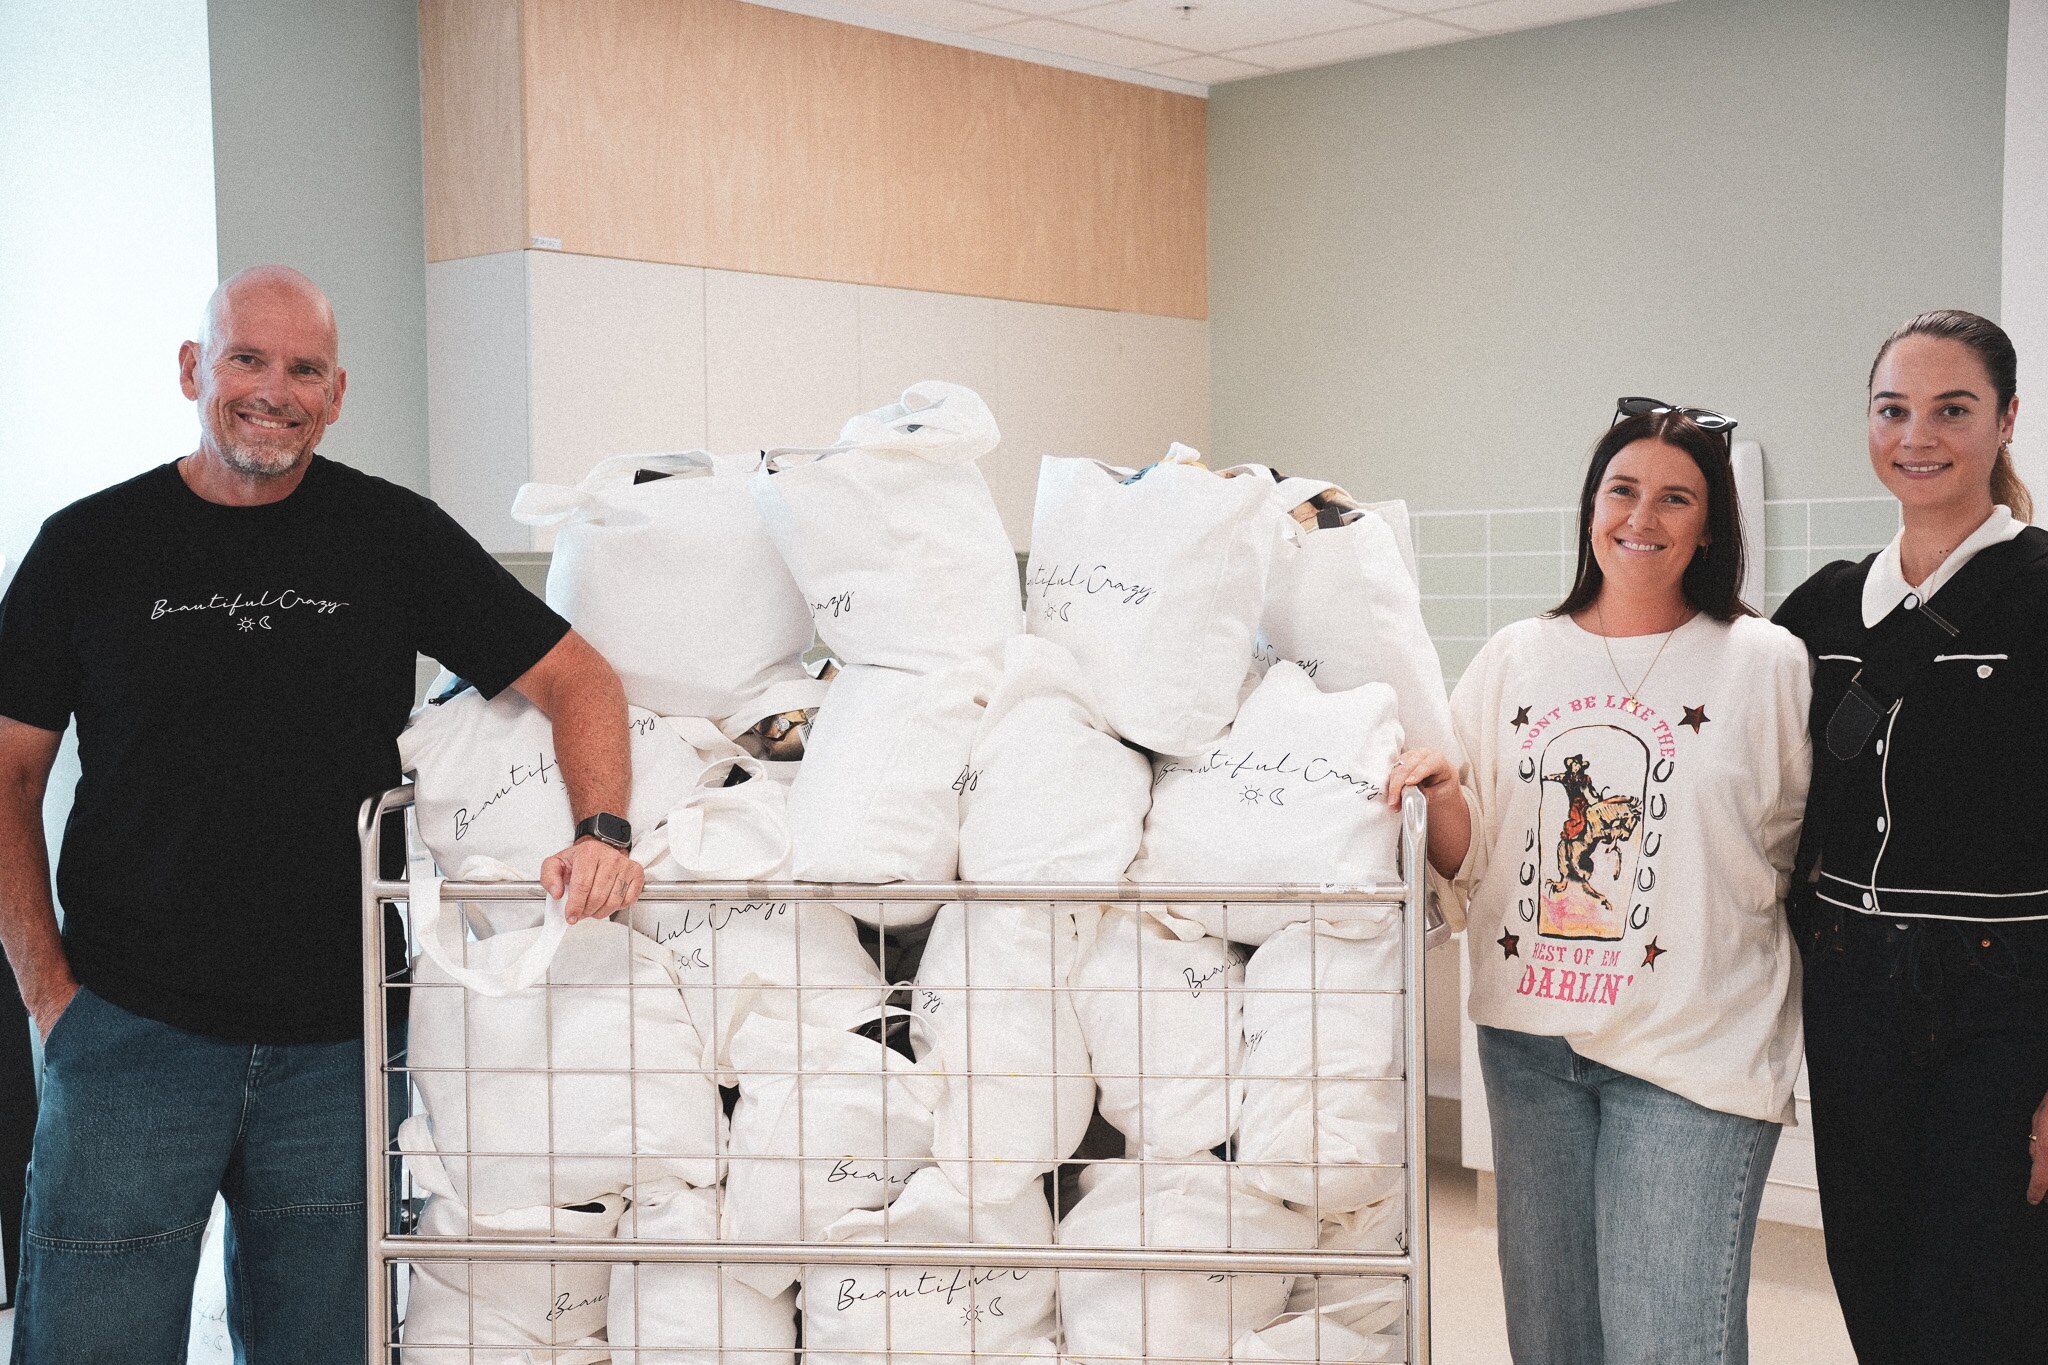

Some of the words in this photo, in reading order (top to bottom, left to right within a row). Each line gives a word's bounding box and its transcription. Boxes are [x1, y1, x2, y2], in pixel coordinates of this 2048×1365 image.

[150, 590, 281, 620] Beautiful
[279, 589, 350, 614] Crazy
[810, 590, 855, 619] razy
[1026, 564, 1085, 598] tiful
[1087, 564, 1156, 605] Crazy
[1568, 695, 1597, 713] BE
[1651, 719, 1676, 758] THE
[1155, 749, 1301, 786] Beautiful
[1303, 757, 1383, 801] Crazy
[453, 752, 559, 841] Beautif
[1573, 947, 1595, 966] OF
[1600, 949, 1622, 968] EM
[1516, 964, 1634, 1006] DARLIN'
[827, 1154, 920, 1185] Beaut
